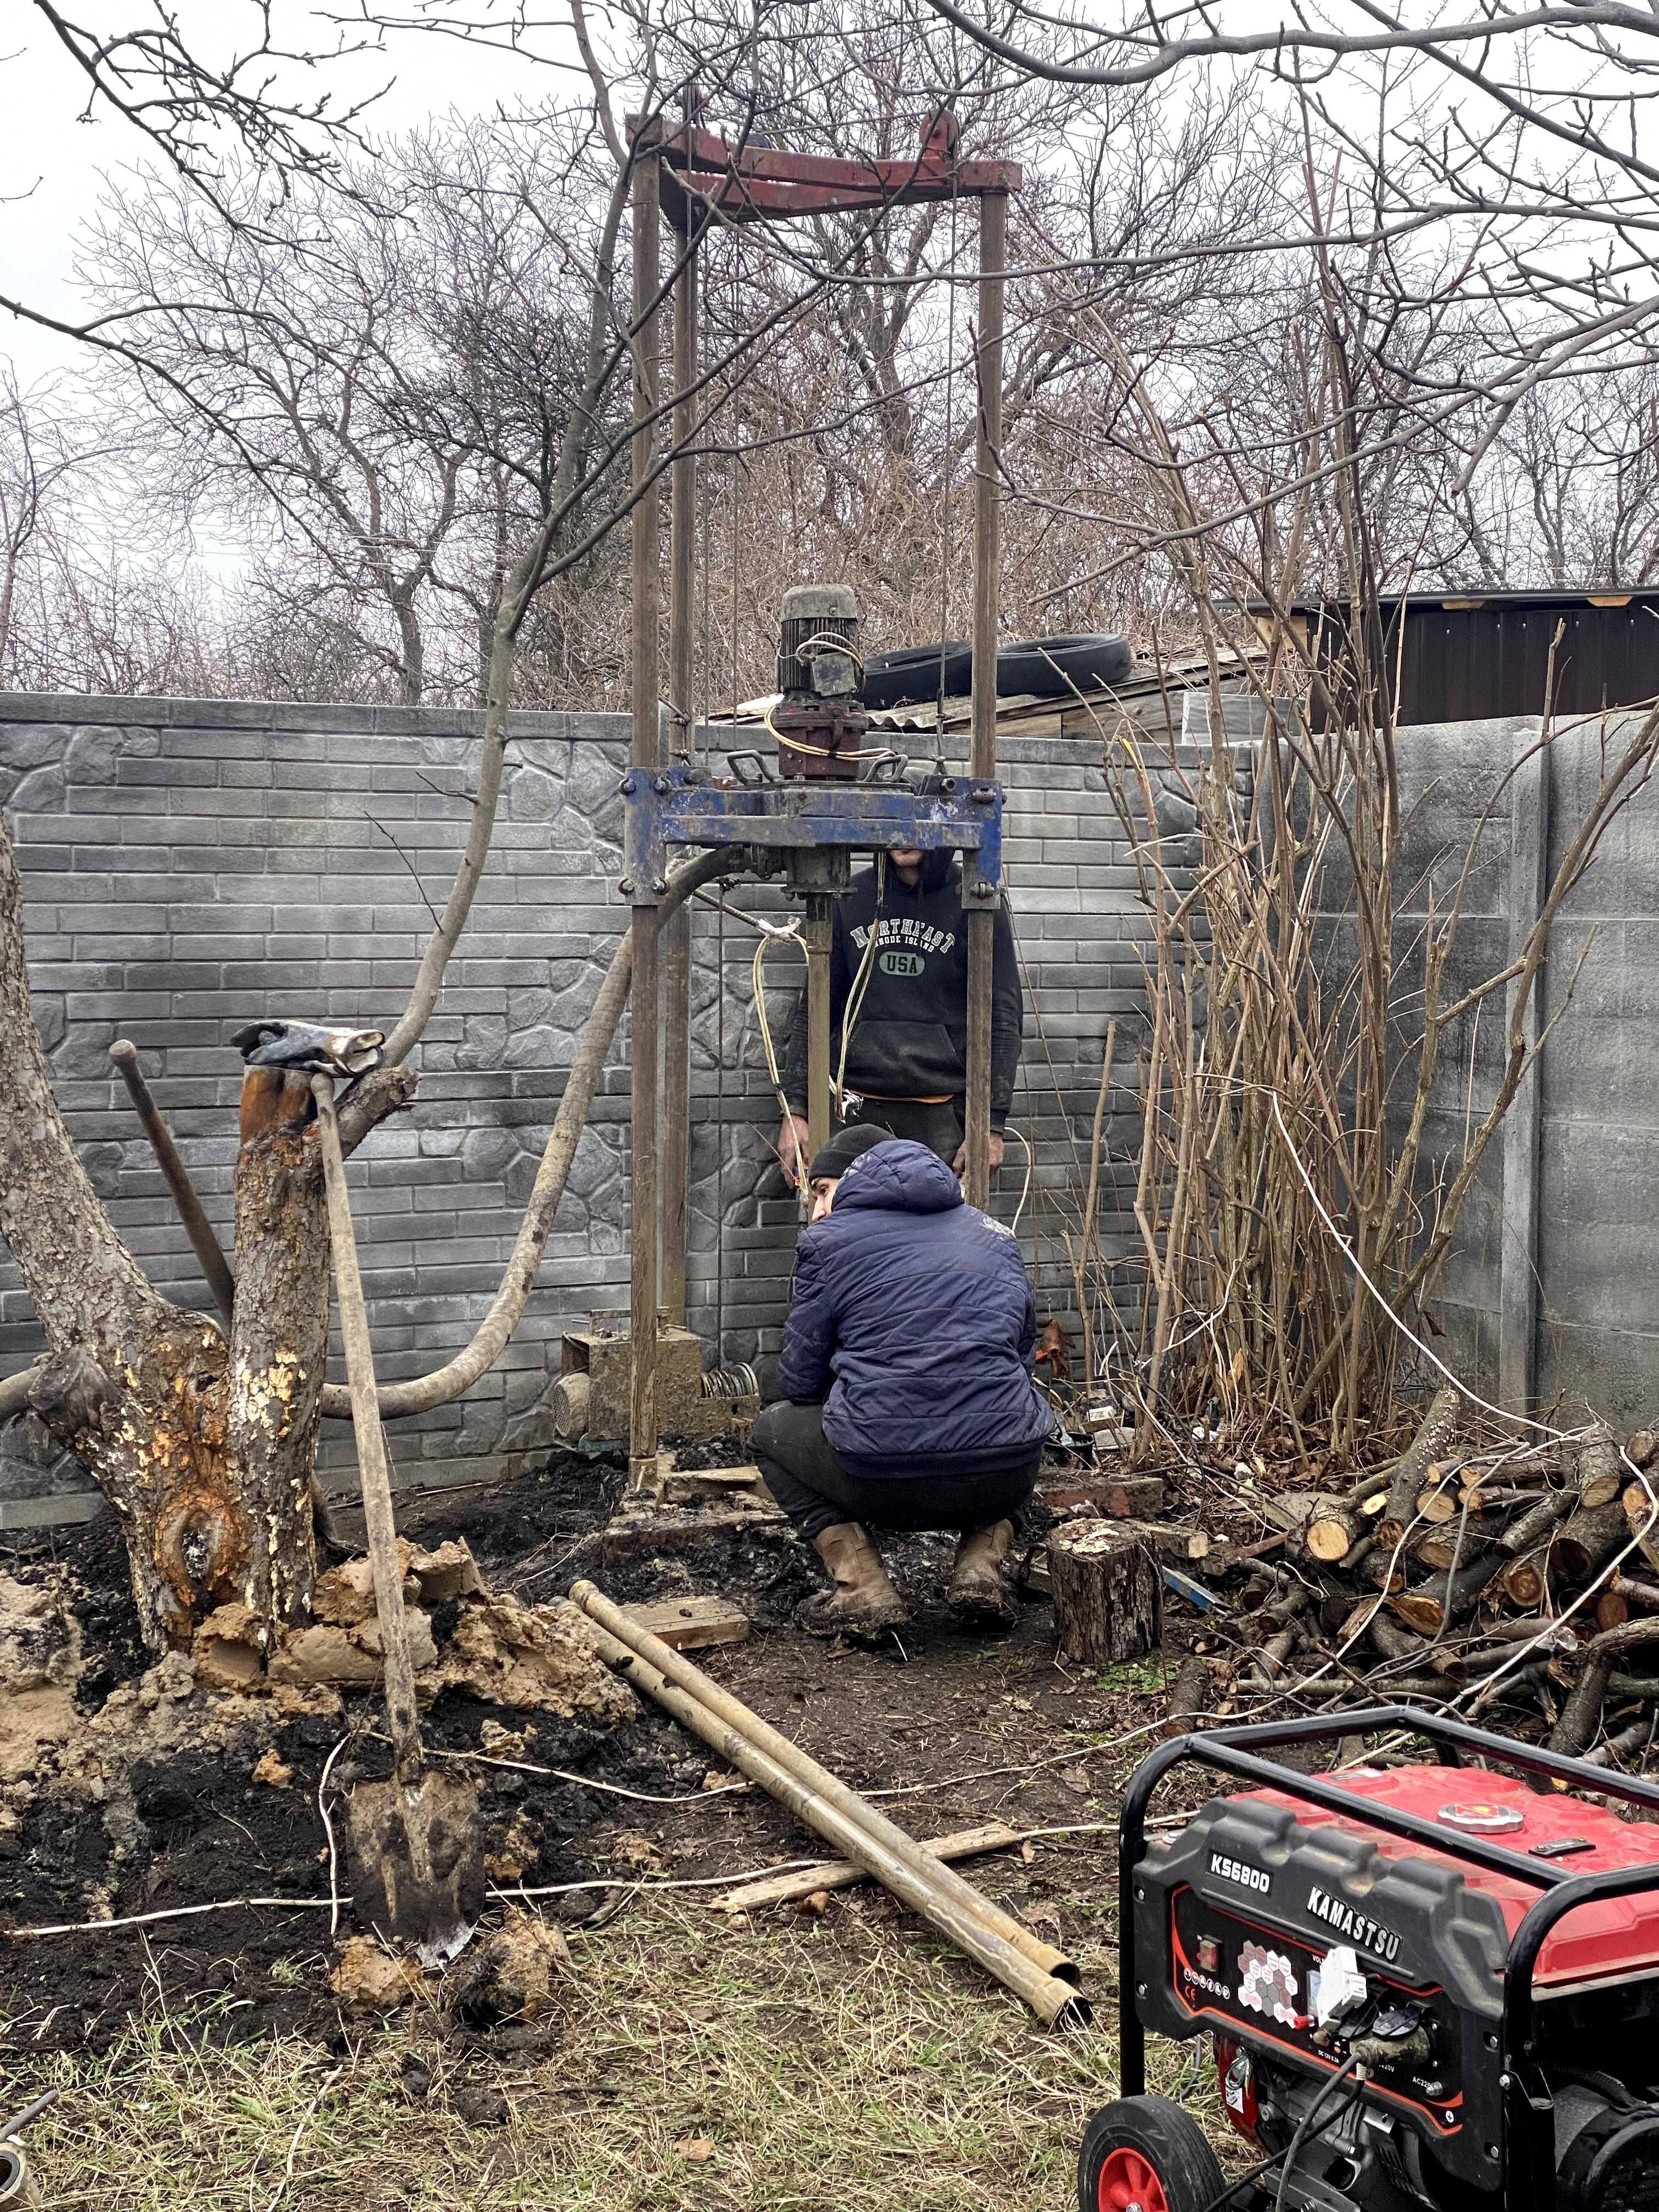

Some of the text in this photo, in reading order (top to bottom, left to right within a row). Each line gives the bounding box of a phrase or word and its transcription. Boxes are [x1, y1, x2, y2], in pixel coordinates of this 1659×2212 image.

[887, 955, 917, 973] USA
[1211, 1854, 1270, 1893] KS6800
[1307, 1886, 1401, 1960] KAMASTSU
